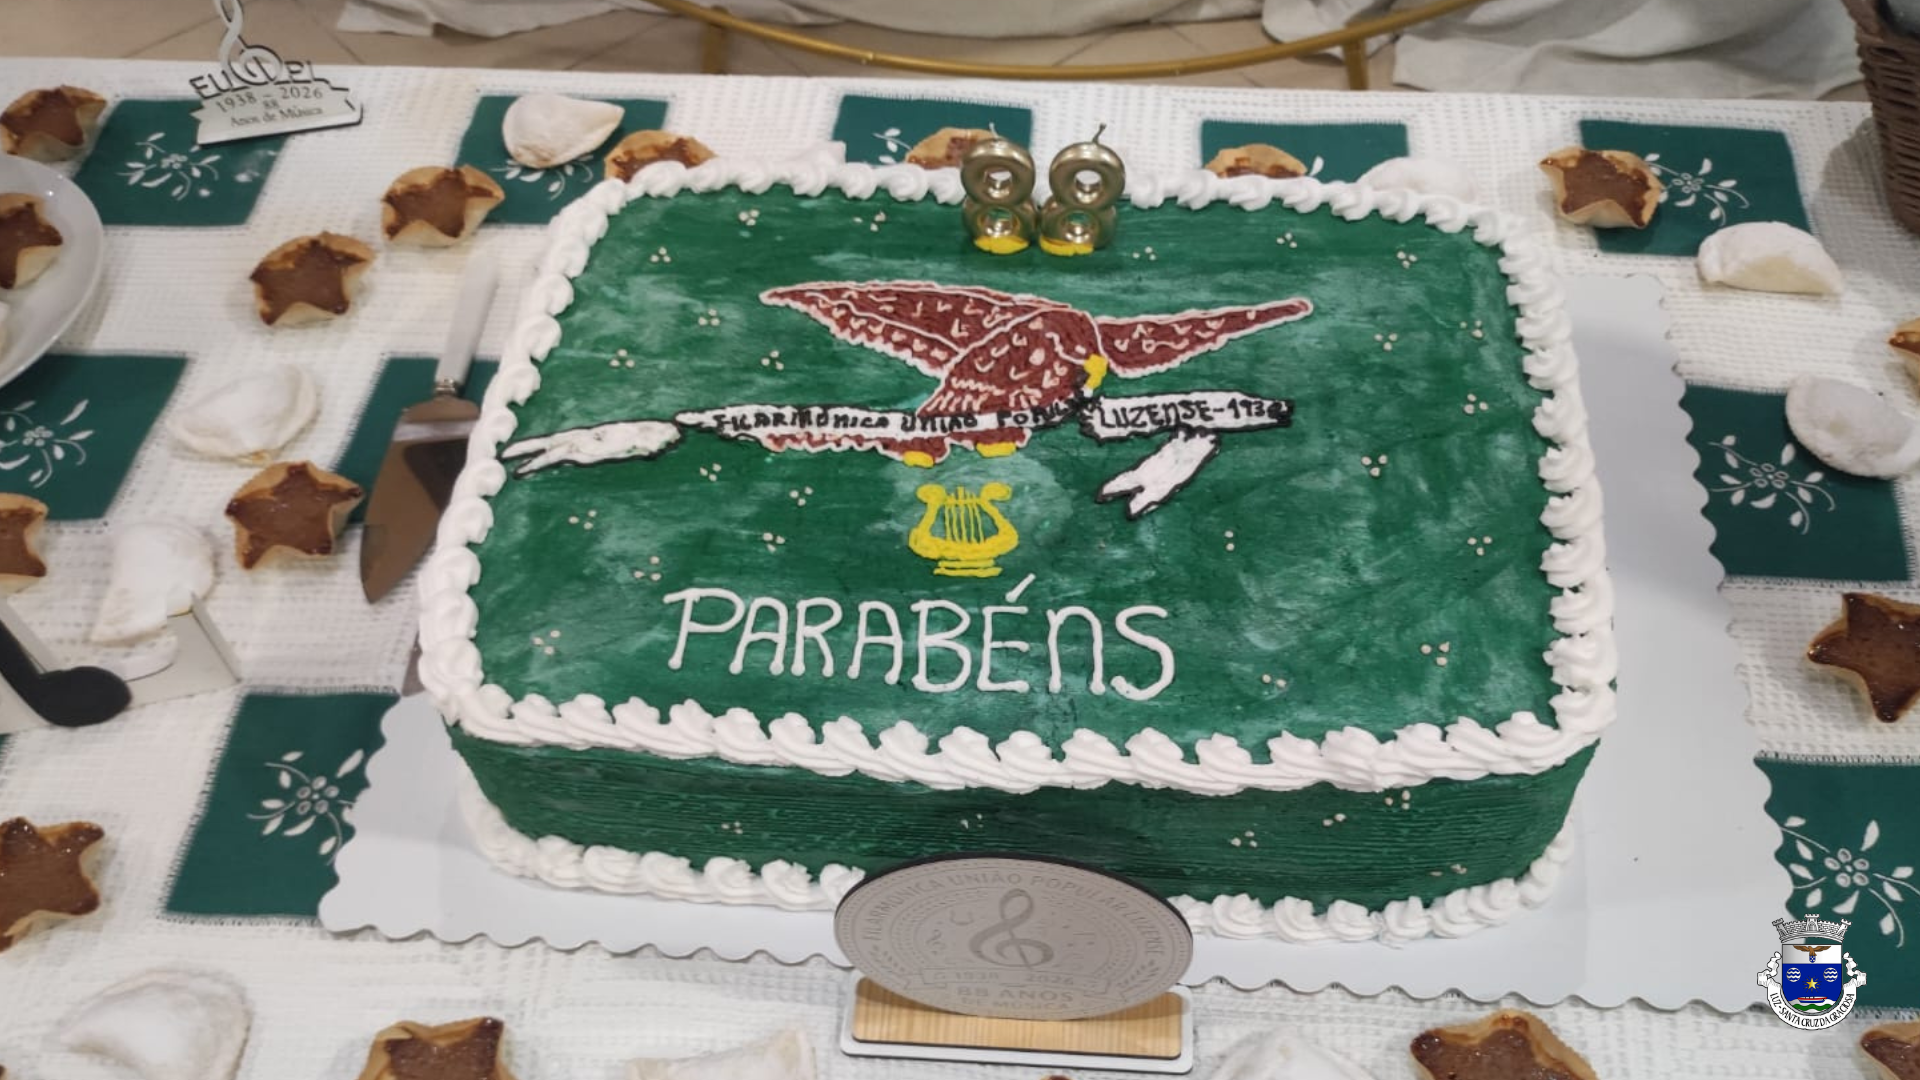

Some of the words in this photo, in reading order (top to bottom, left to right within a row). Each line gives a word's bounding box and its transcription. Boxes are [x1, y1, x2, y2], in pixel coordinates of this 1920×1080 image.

[215, 91, 257, 113] 1938
[279, 86, 323, 99] 2026
[263, 111, 276, 122] de
[663, 574, 1175, 700] PARABÉNS
[999, 988, 1074, 1002] ANOS
